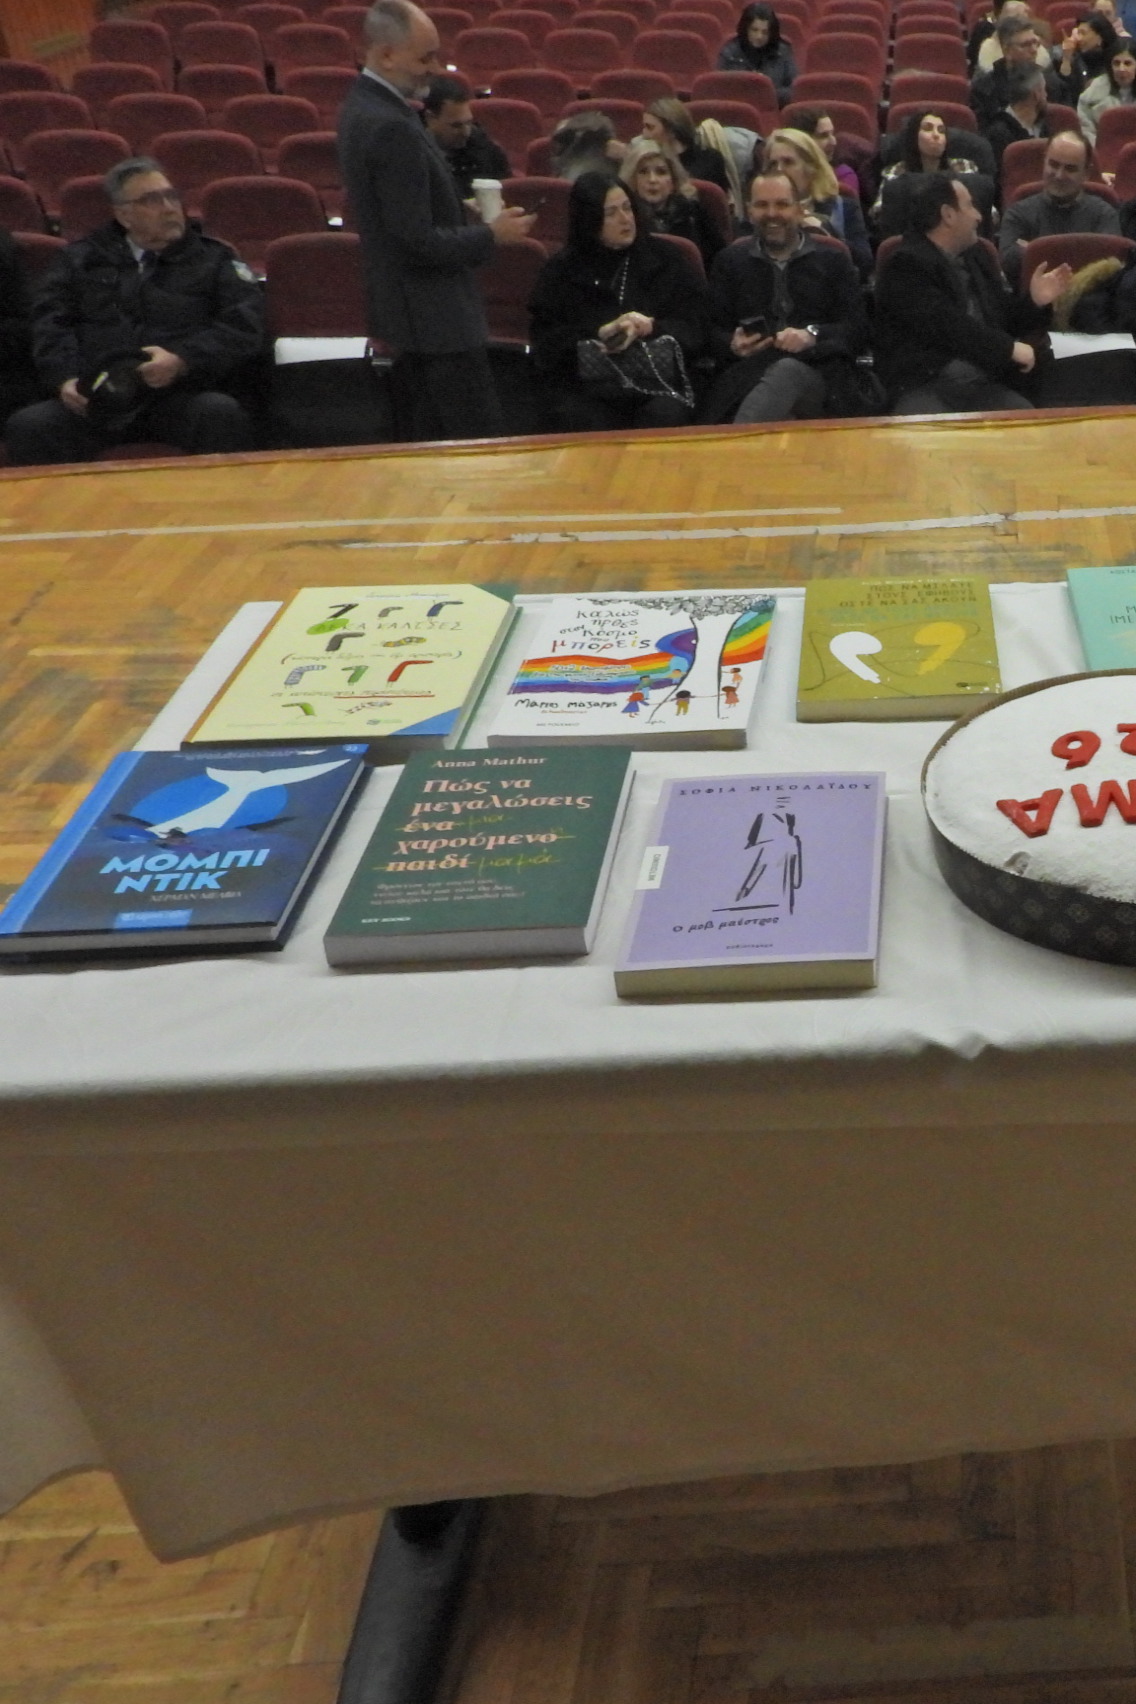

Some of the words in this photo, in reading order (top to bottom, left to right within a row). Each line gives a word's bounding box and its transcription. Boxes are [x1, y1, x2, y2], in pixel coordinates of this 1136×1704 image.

[432, 758, 476, 769] Anna
[482, 755, 548, 767] Mathur
[422, 779, 491, 794] Πώς
[500, 779, 532, 790] να
[679, 787, 736, 796] ΣΟΦΙΑ
[750, 782, 872, 792] ΝΙΚΟΛΑΪΔΟΥ
[411, 794, 593, 816] μεγαλώσεις
[393, 832, 558, 855] χαρούμενο
[99, 849, 270, 874] ΜΟΜΠΙ
[385, 853, 472, 872] παιδί
[114, 870, 229, 894] ΝΤΙΚ
